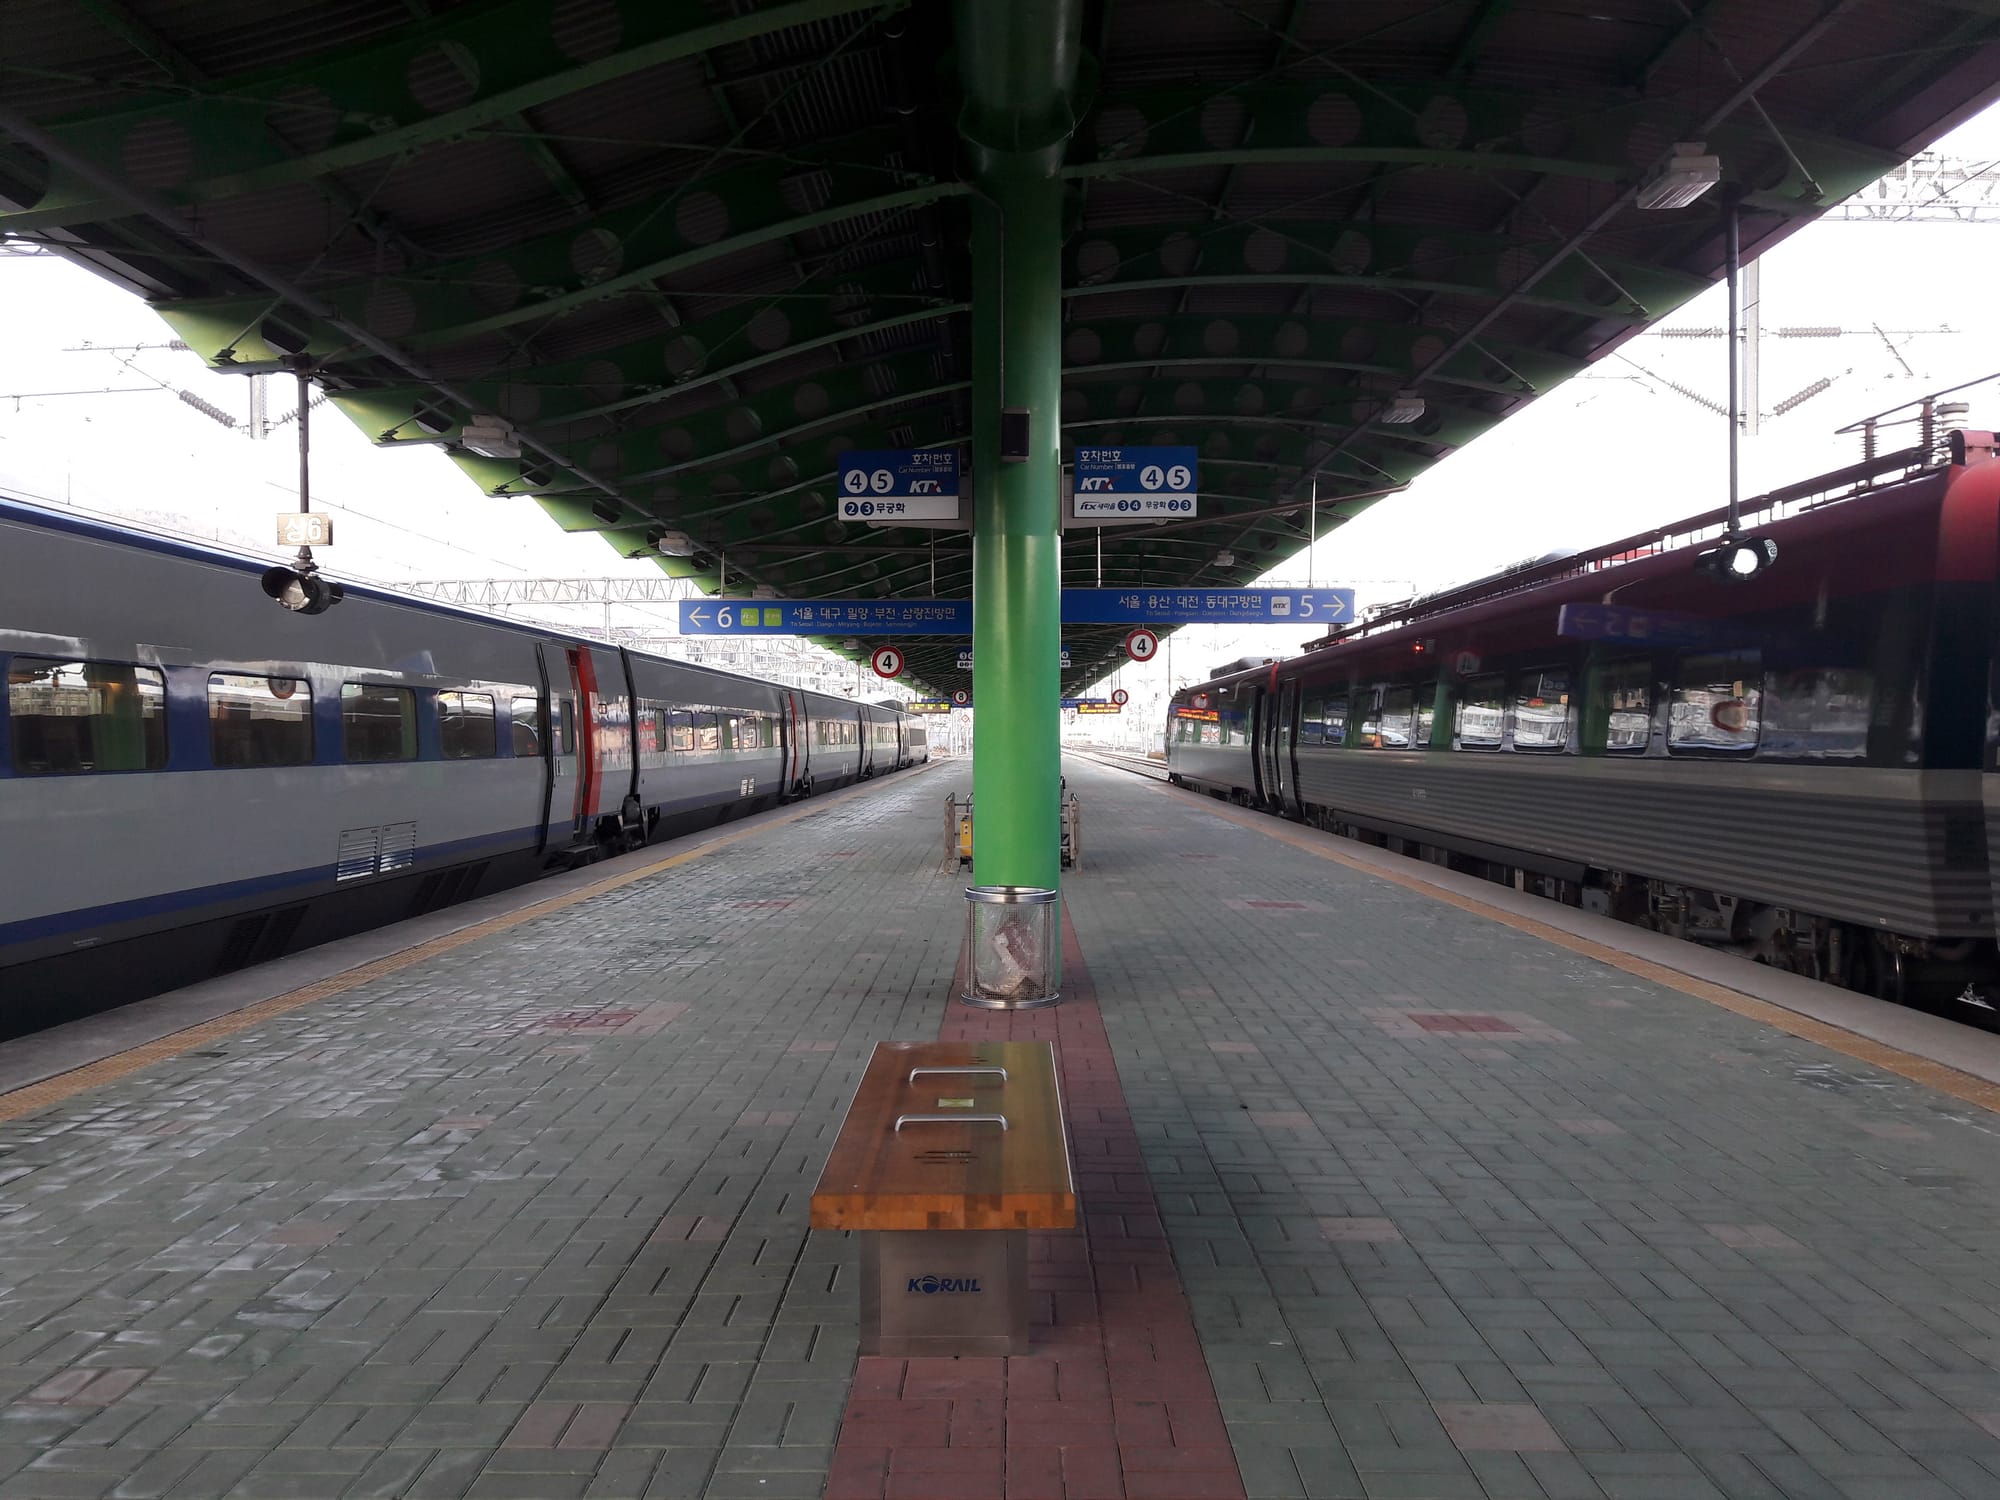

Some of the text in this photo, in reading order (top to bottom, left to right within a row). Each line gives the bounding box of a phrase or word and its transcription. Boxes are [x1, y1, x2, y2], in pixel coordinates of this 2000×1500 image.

[912, 453, 953, 465] 호차번호
[1080, 450, 1121, 462] 호차번호
[909, 480, 944, 494] KTX
[1080, 477, 1116, 491] KTX
[876, 502, 906, 515] 무궁화
[1145, 501, 1167, 510] 무궁화
[1118, 595, 1140, 609] 서울
[1148, 595, 1170, 609] 용산
[1176, 595, 1199, 609] 대전
[1206, 595, 1262, 609] 동대구방면
[1299, 595, 1314, 617] 5
[717, 606, 733, 628] 6
[792, 607, 813, 620] 서울
[820, 607, 841, 620] 대구
[847, 607, 869, 620] 밀양
[875, 607, 896, 620] 부전
[902, 607, 956, 620] 삼랑진방면
[1137, 638, 1147, 653] 4
[882, 654, 893, 669] 4
[958, 692, 964, 701] 8
[908, 1276, 982, 1294] KORAIL
